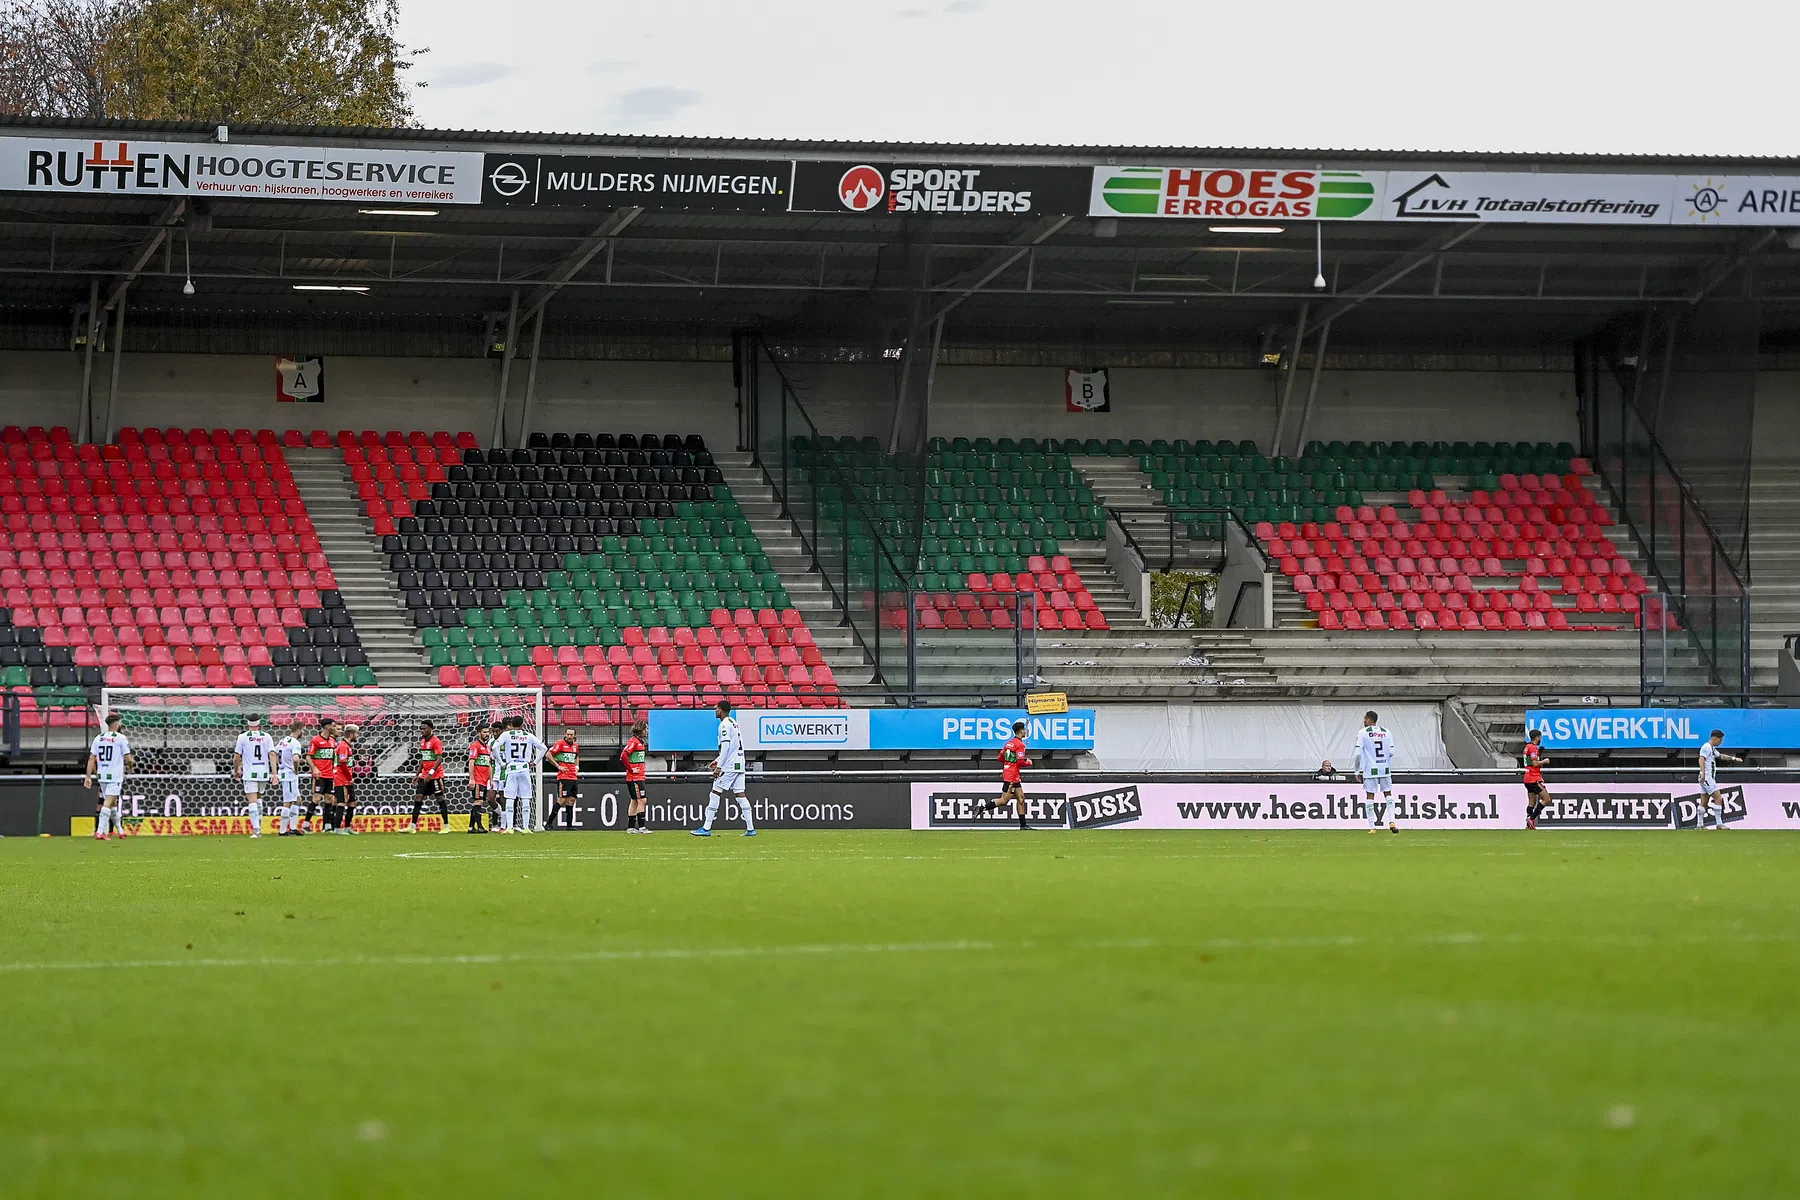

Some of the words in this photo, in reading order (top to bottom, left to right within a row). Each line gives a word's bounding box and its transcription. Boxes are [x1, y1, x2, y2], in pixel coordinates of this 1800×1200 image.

[196, 156, 455, 185] HOOGTESERVICE
[889, 169, 981, 190] SPORT
[197, 181, 236, 192] Verhuur
[239, 184, 261, 193] van:
[264, 184, 320, 195] hijskranen,
[322, 186, 387, 198] hoogwerkers
[390, 189, 403, 198] en
[406, 190, 454, 200] verreikers
[547, 172, 655, 192] MULDERS
[662, 174, 783, 194] NIJMEGEN.
[1166, 169, 1316, 199] HOES
[896, 190, 1031, 212] SNELDERS
[1164, 199, 1312, 217] ERROGAS
[1411, 200, 1469, 210] JVH
[1475, 197, 1660, 218] Totaalstoffering
[1737, 190, 1800, 213] ARIE
[294, 372, 307, 389] A
[1082, 384, 1094, 399] B
[98, 746, 113, 761] 20
[254, 745, 262, 760] 4
[510, 743, 528, 758] 27
[1374, 741, 1384, 757] 2
[1073, 791, 1138, 822] DISK
[1177, 794, 1500, 826] www.healthydisk.nl
[1540, 799, 1671, 819] HEALTHY
[1679, 791, 1742, 822] DSK
